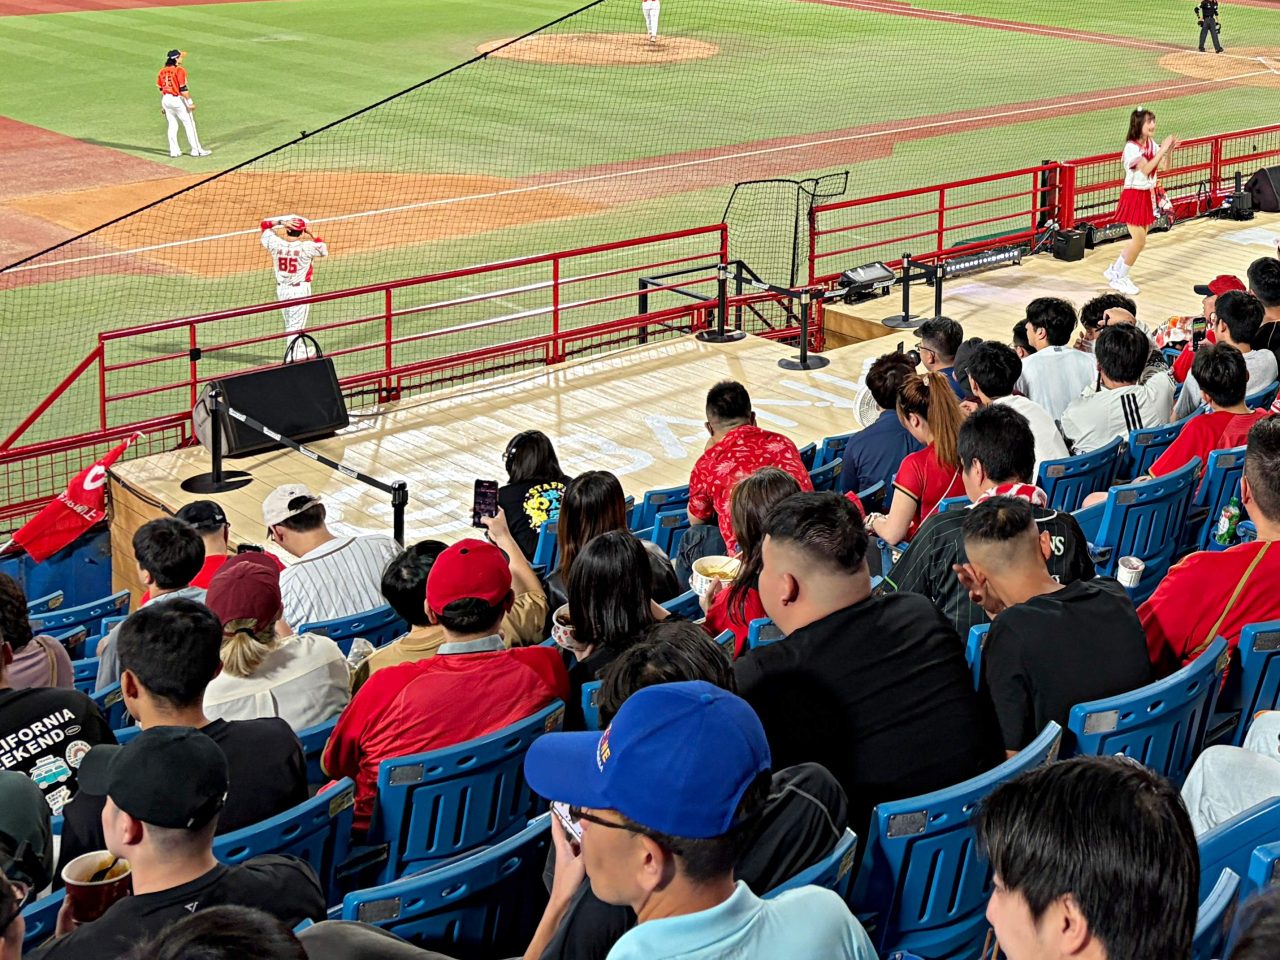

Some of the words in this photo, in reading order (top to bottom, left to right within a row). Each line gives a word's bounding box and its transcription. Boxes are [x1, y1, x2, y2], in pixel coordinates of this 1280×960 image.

[278, 257, 298, 274] 85
[529, 481, 565, 496] STAFF
[0, 728, 65, 771] EKEND
